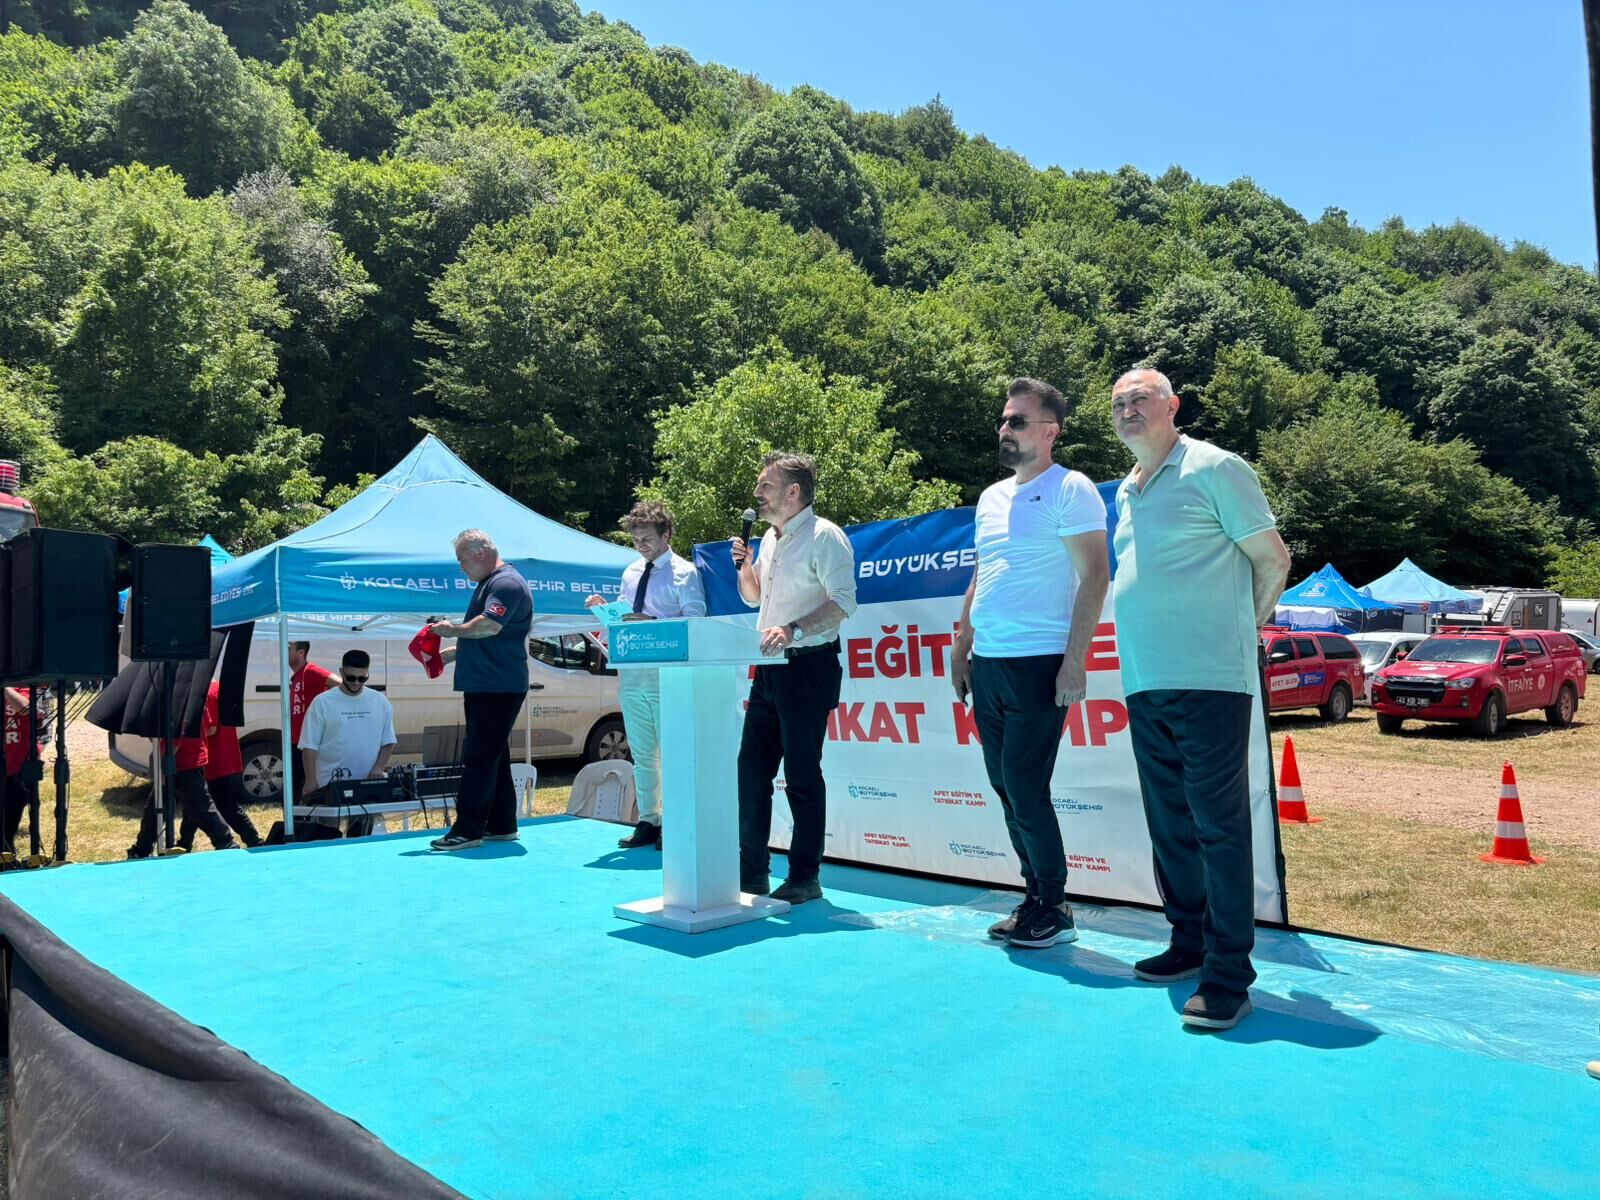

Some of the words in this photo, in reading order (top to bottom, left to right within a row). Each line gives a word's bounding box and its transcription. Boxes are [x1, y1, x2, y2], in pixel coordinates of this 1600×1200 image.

[859, 548, 977, 578] BÜYÜKŞE
[570, 582, 622, 594] BELED
[847, 622, 960, 679] EĞİT
[1054, 803, 1103, 811] ÜYÜKŞEHİR
